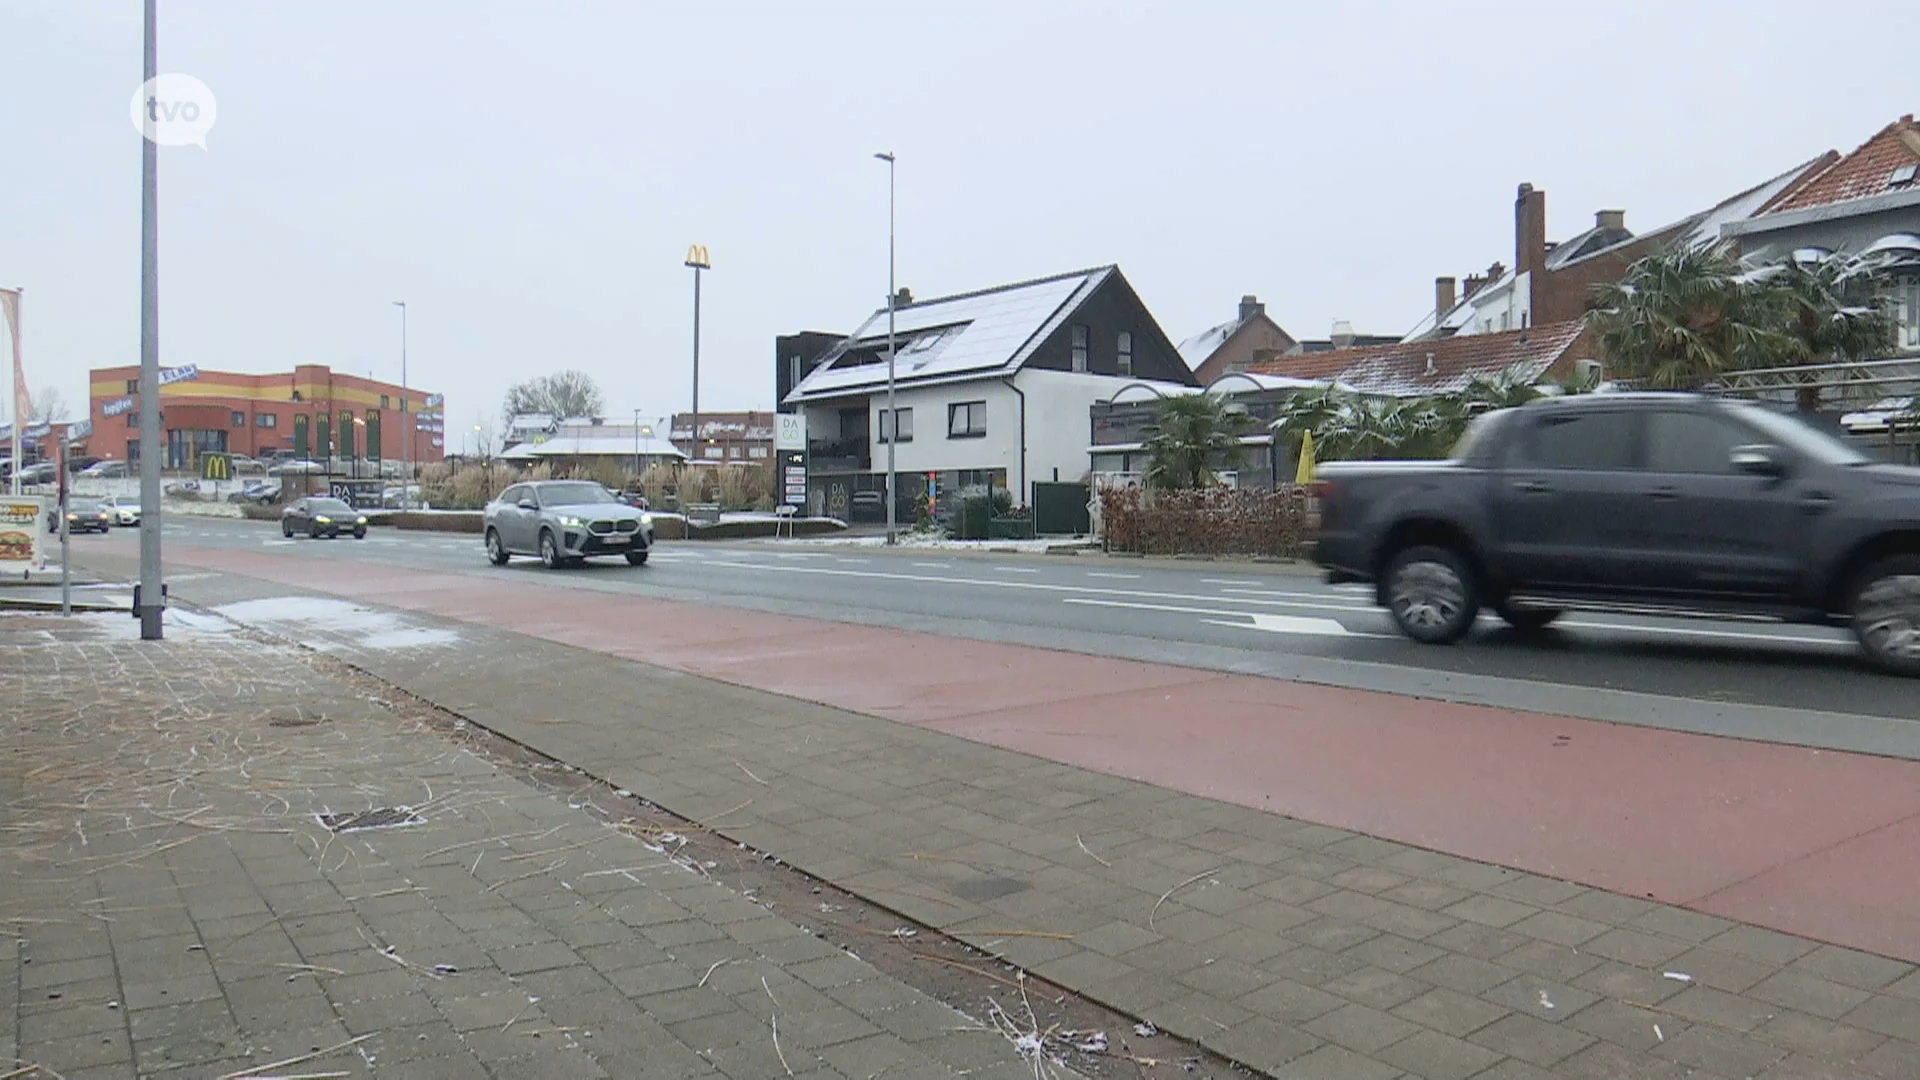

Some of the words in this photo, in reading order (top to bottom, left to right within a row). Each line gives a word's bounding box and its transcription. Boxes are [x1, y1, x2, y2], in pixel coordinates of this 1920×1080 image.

[687, 244, 710, 267] M
[207, 455, 227, 480] M
[333, 485, 351, 496] DA
